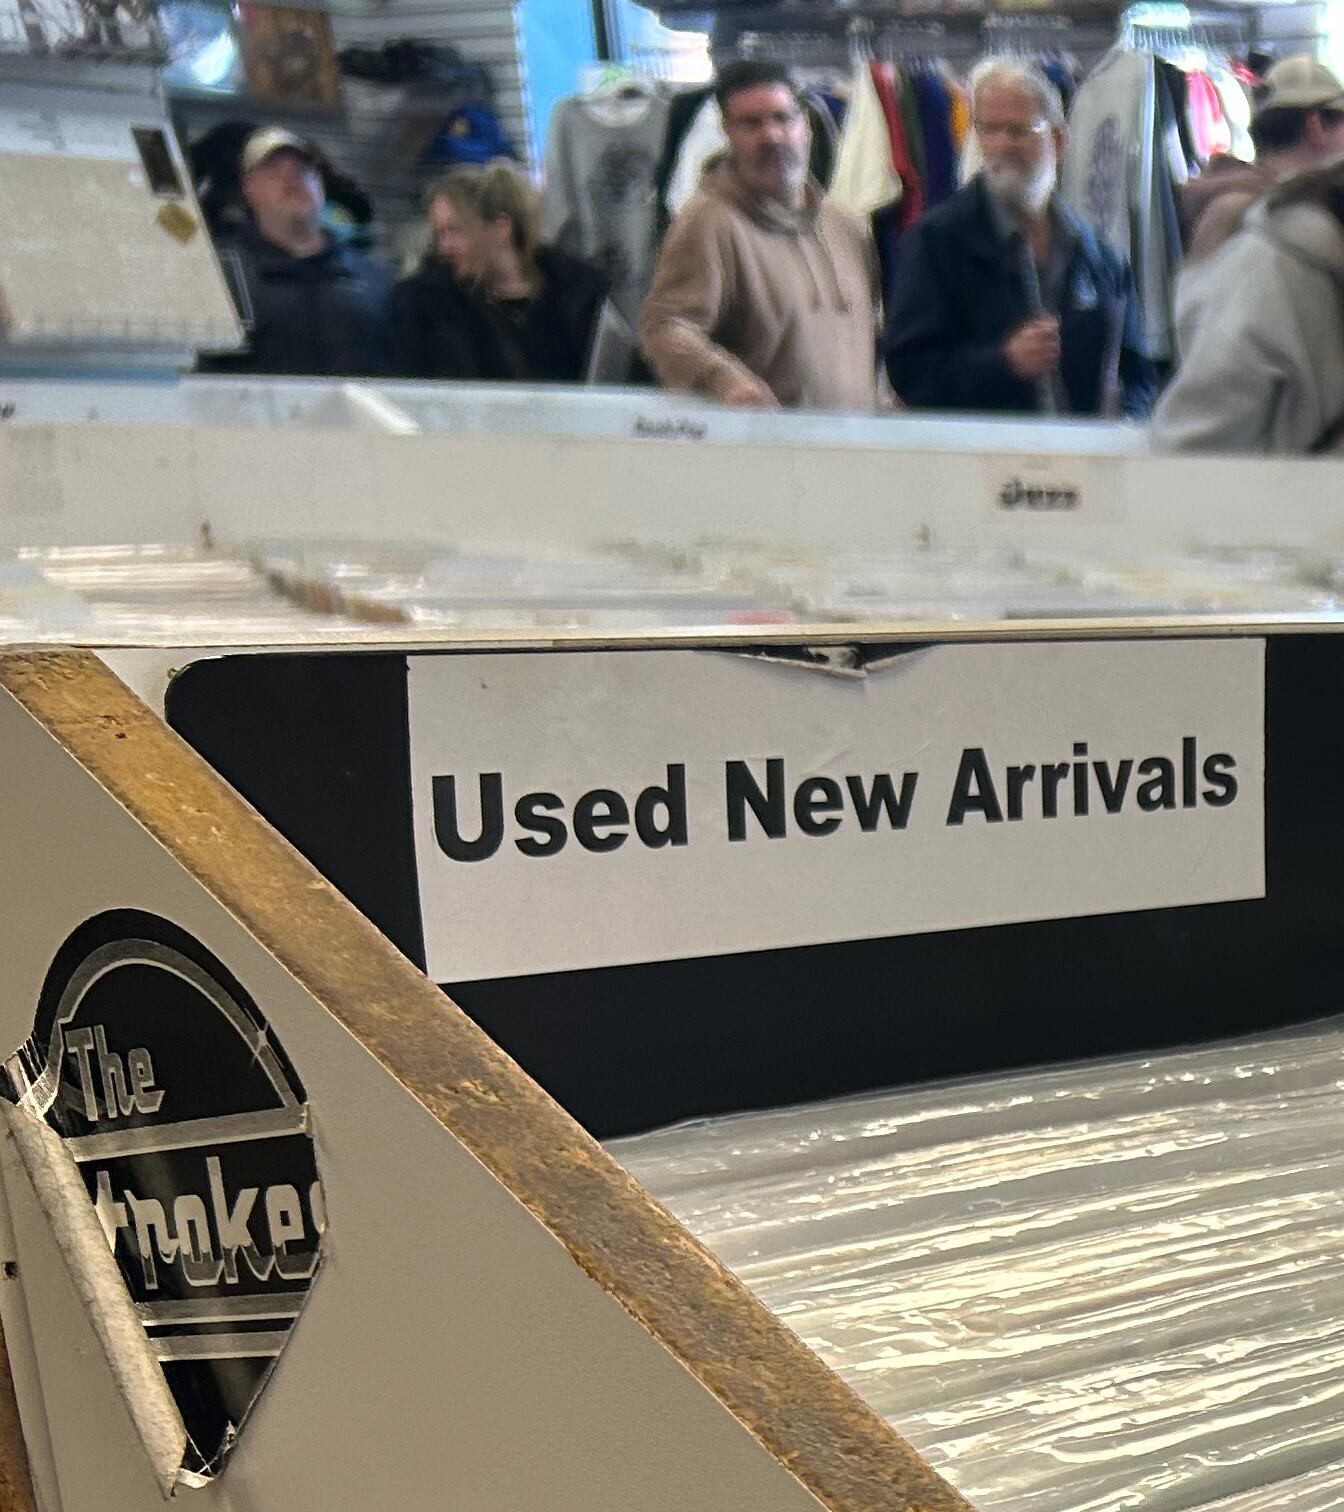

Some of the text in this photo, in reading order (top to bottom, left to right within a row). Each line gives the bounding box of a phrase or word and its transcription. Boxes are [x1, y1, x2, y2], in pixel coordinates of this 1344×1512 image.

[431, 736, 1239, 863] Used New Arrivals
[65, 1023, 165, 1122] The
